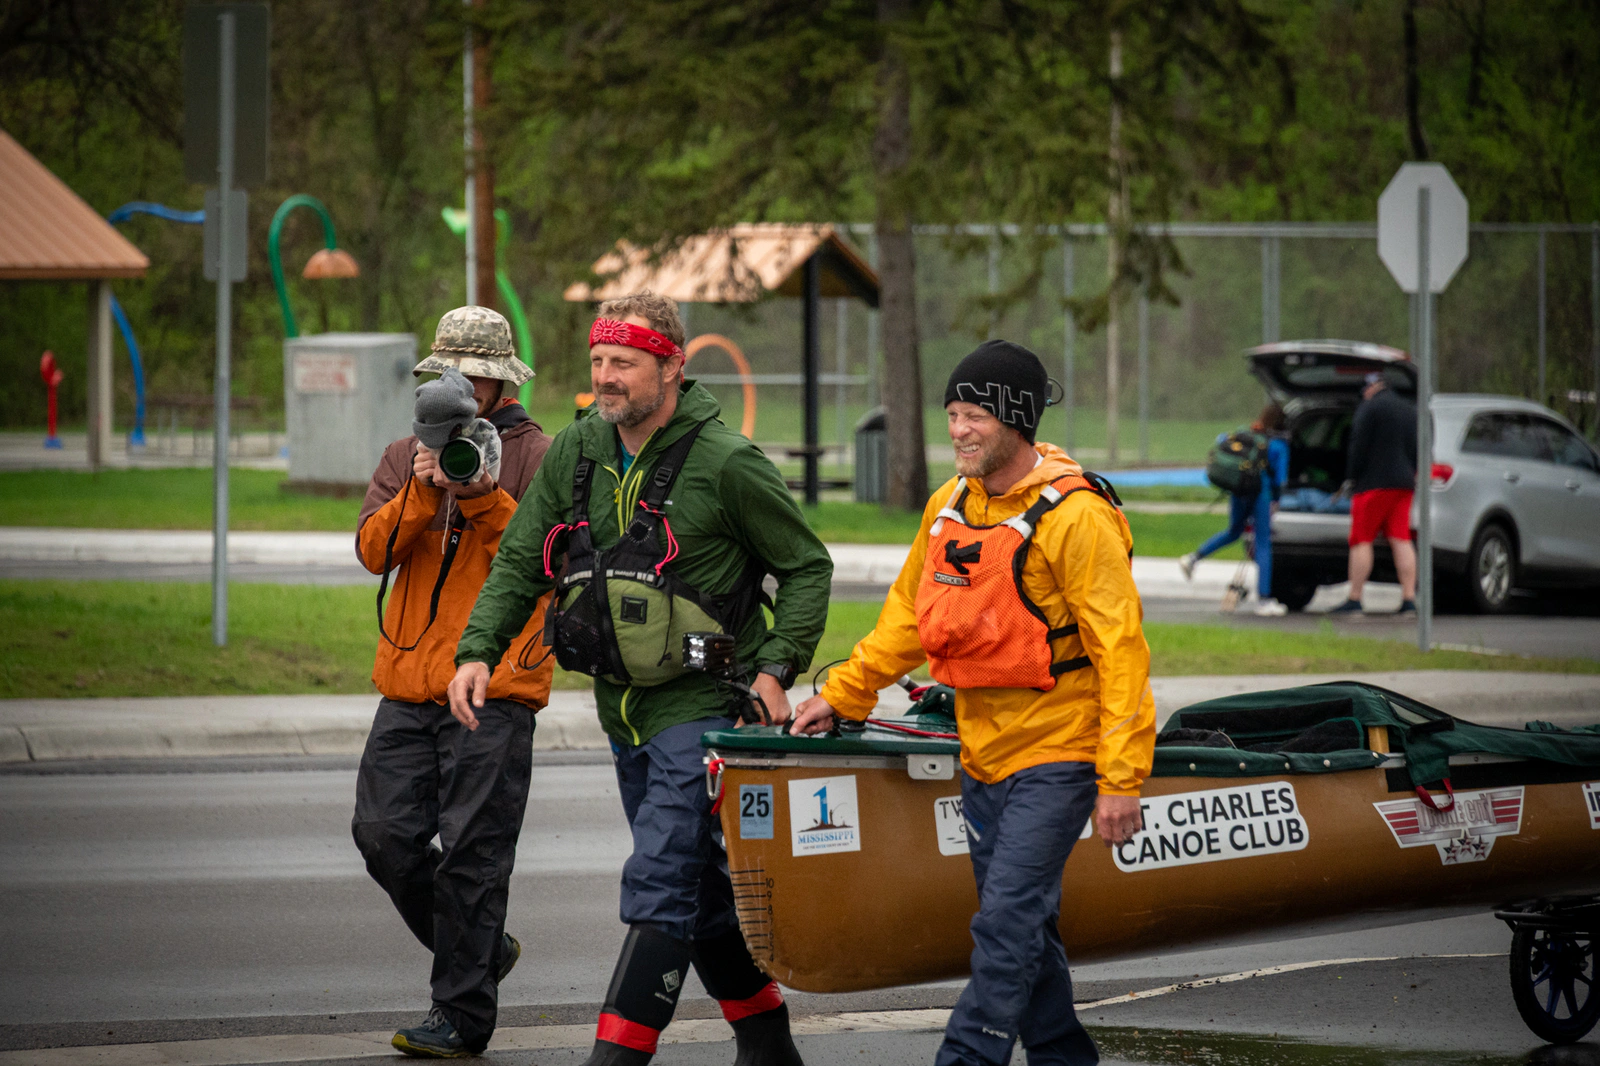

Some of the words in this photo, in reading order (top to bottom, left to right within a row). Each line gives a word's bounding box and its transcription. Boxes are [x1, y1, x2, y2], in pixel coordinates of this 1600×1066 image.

[741, 791, 770, 818] 25
[1139, 804, 1161, 831] T.
[1167, 787, 1295, 827] CHARLES
[797, 831, 854, 844] MISSISSIPPI
[1117, 828, 1222, 866] CANOE
[1229, 818, 1304, 851] CLUB
